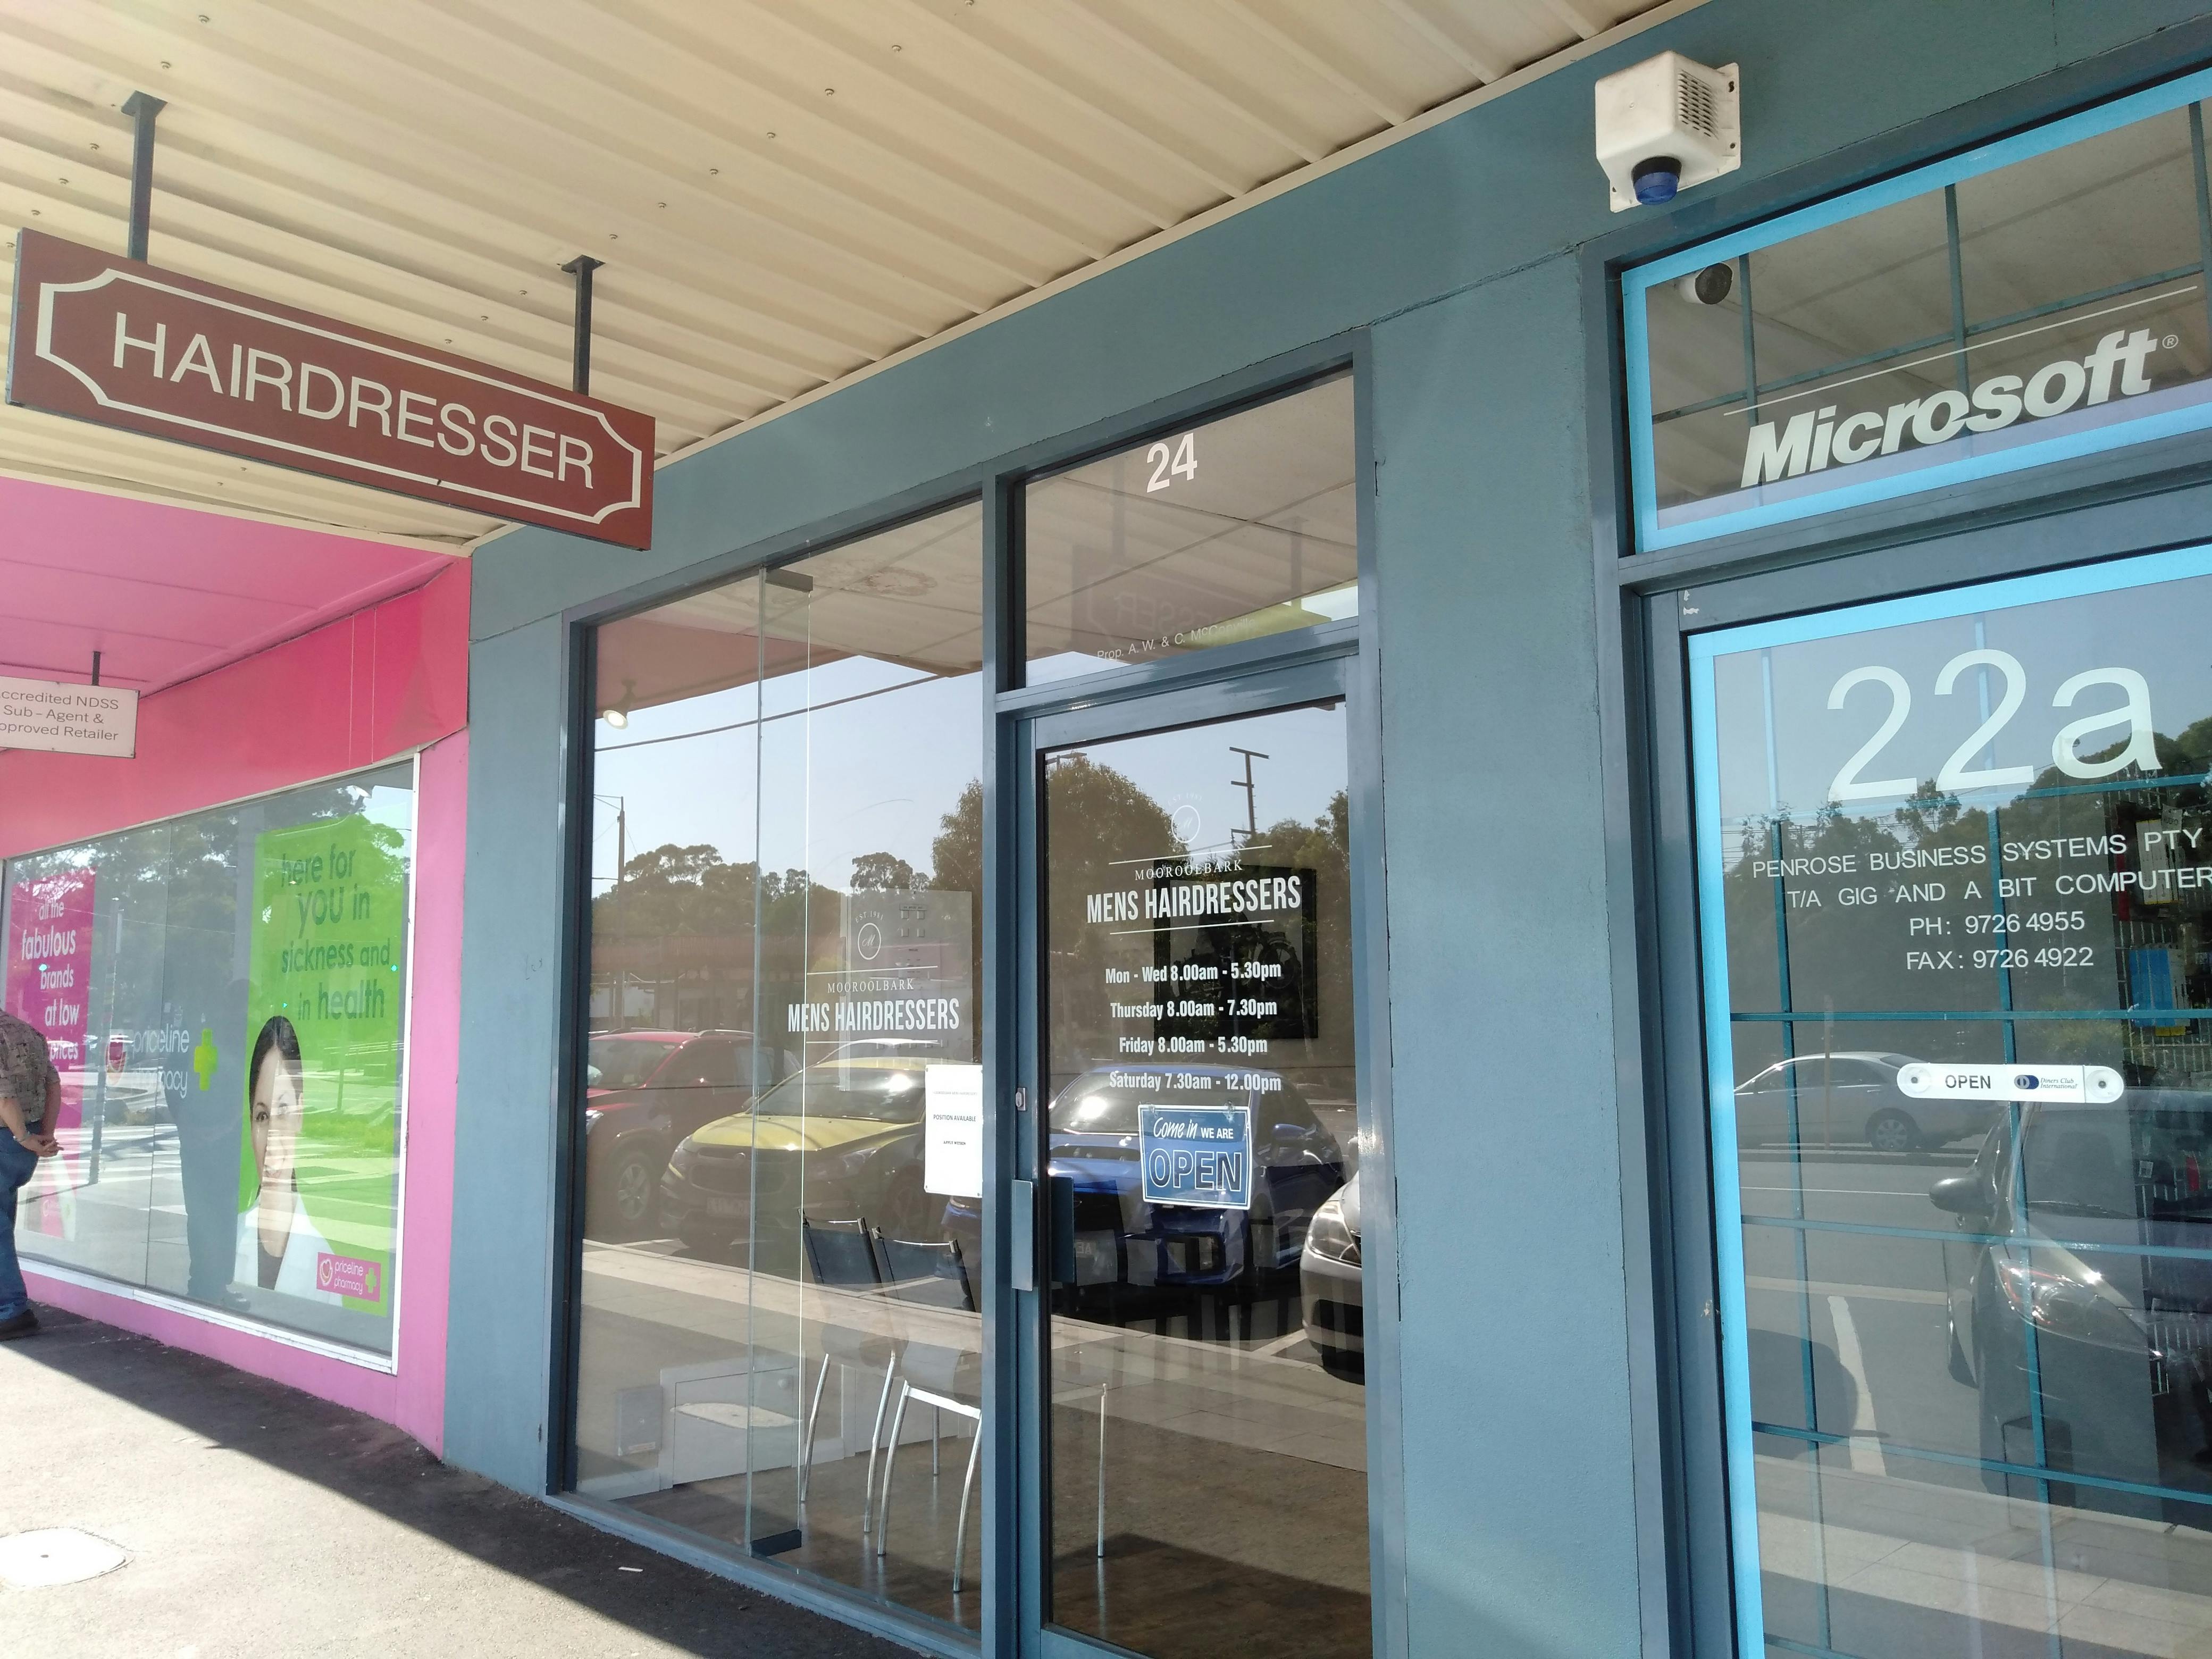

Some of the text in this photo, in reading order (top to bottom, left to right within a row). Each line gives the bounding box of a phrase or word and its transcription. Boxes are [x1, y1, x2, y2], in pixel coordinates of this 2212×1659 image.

[113, 312, 596, 489] HAIRDRESSER
[1740, 329, 2158, 488] Microsoft
[1146, 432, 1197, 492] 24
[1097, 648, 1124, 661] Prop.
[1161, 636, 1169, 647] &
[1175, 633, 1185, 645] C.
[0, 691, 119, 709] ccredited NDSS
[46, 709, 89, 722] Agent
[93, 713, 104, 724] &
[1826, 648, 2163, 802] 22a
[0, 722, 119, 740] pproved Retailer
[281, 843, 356, 887] here for
[1753, 828, 2203, 878] PENROSE BUSINESS SYSTEMS PTY
[1135, 859, 1243, 881] MOOROOLBARK
[1087, 875, 1301, 924] MENS HAIRDRESSERS
[1787, 866, 2212, 908] T/A GIG AND A BIT COMPUTER
[353, 883, 370, 920] in
[1909, 911, 2085, 936] PH: 9726 4955
[21, 925, 76, 960] fabulous
[281, 937, 390, 973] sickness and
[1105, 968, 1129, 983] Mon
[1142, 966, 1167, 982] Wed
[1170, 964, 1218, 981] 8.00am
[1230, 961, 1281, 981] 5.30pm
[1907, 946, 2093, 970] FAX: 9726 4922
[40, 963, 73, 990] brands
[827, 978, 915, 993] MOOROOLBARK
[45, 999, 80, 1027] at low
[298, 978, 384, 1020] in health
[1110, 1001, 1163, 1021] Thursday
[1167, 1000, 1214, 1017] 8.00am
[1227, 999, 1277, 1019] 7.30pm
[788, 998, 959, 1032] MENS HAIRDRESSERS
[132, 1023, 190, 1060] priceline
[1119, 1037, 1154, 1055] Friday
[1158, 1036, 1205, 1053] 8.00am
[1218, 1036, 1268, 1056] 5.30pm
[1109, 1071, 1161, 1092] Saturday
[1164, 1073, 1211, 1089] 7.30am
[1225, 1074, 1281, 1094] 12.00pm
[1945, 1074, 1991, 1089] OPEN
[1153, 1117, 1234, 1139] Come in WE ARE
[1149, 1148, 1242, 1192] OPEN
[334, 1260, 363, 1276] priceline
[334, 1277, 363, 1295] pharmacy
